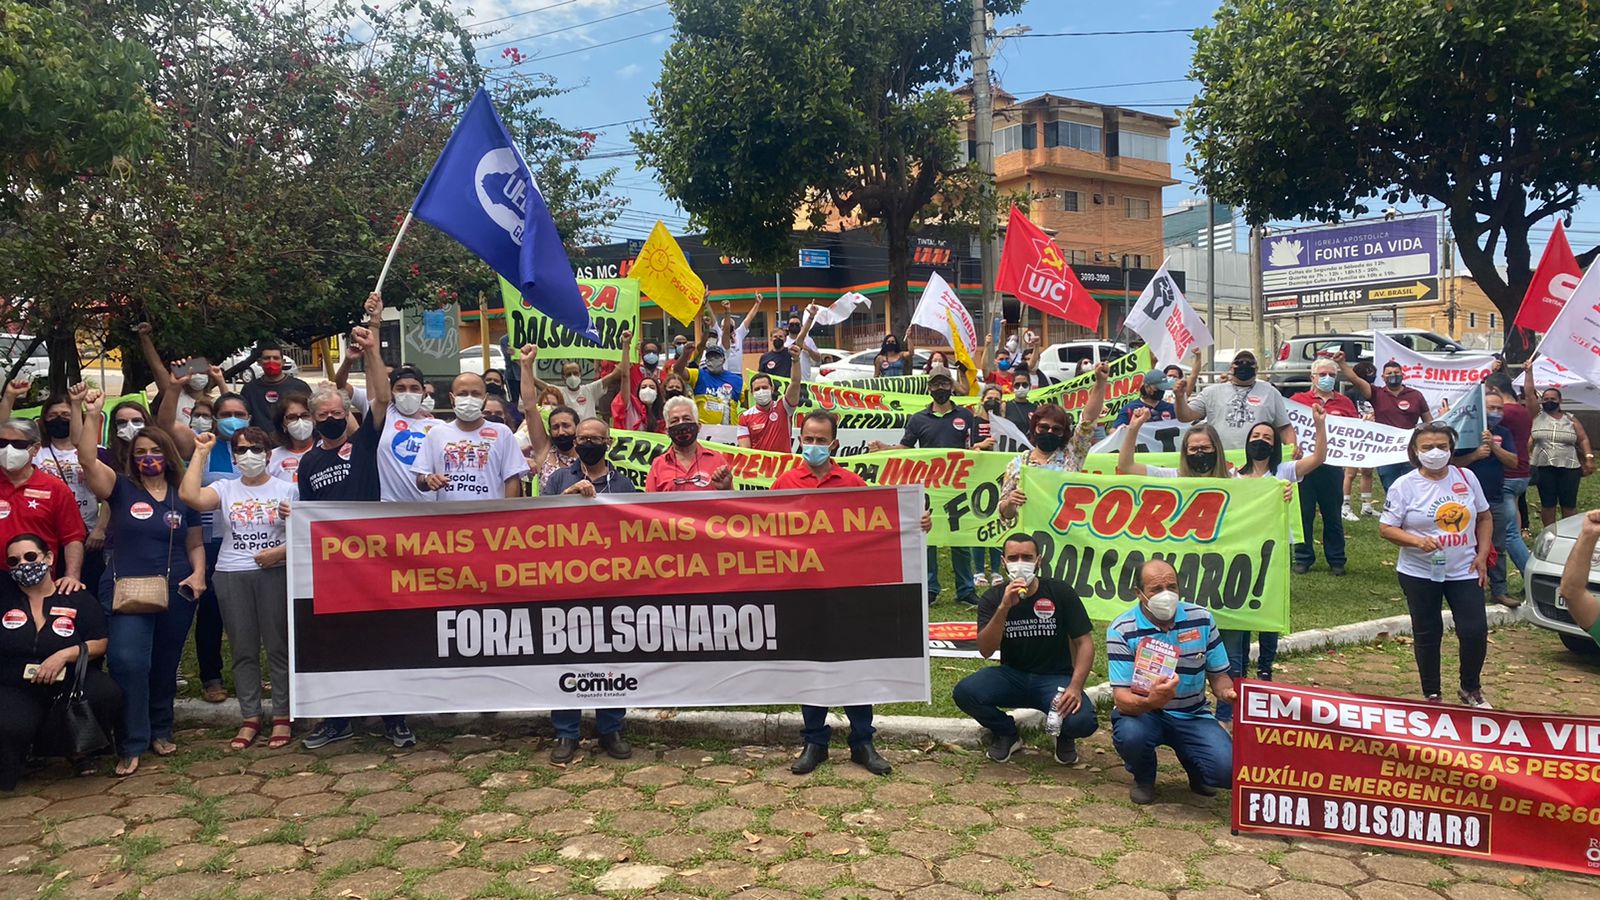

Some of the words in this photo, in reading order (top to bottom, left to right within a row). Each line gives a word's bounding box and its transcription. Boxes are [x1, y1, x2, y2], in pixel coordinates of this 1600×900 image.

[1314, 239, 1340, 247] IGREJA
[1314, 244, 1359, 261] FONTE
[1364, 242, 1384, 255] DA
[1387, 237, 1423, 253] VIDA
[596, 264, 618, 278] MC
[671, 276, 689, 296] PSOL
[688, 293, 700, 305] 50
[1028, 271, 1066, 302] UJC
[1302, 289, 1363, 304] unitintas
[1373, 290, 1385, 298] AV.
[1387, 288, 1413, 296] BRASIL
[1108, 352, 1138, 378] AIS
[1424, 367, 1491, 382] SINTEGO
[811, 383, 890, 411] VIDA
[1061, 373, 1145, 410] VAINA
[838, 412, 913, 430] RETORN
[1302, 429, 1347, 449] PEAS
[1349, 437, 1409, 454] VÍTIMAS
[1327, 423, 1394, 445] VERDADE
[1396, 436, 1407, 444] E
[1299, 440, 1366, 462] COID-19
[878, 451, 974, 490] MORTE
[457, 482, 489, 494] Praça
[1050, 482, 1230, 543] FORA
[232, 532, 268, 541] Escola
[233, 541, 246, 550] da
[321, 534, 388, 560] POR
[395, 529, 475, 557] MAIS
[482, 521, 611, 551] VACINA,
[619, 516, 697, 543] MAIS
[704, 509, 835, 539] COMIDA
[843, 506, 893, 532] NA
[1438, 533, 1468, 549] VIDA
[391, 566, 488, 593] MESA,
[496, 553, 710, 589] DEMOCRACIA
[717, 548, 825, 576] PLENA
[1031, 530, 1276, 610] BOLSOARO!
[436, 608, 535, 658] FORA
[542, 604, 778, 656] BOLSONARO!
[559, 672, 638, 693] Comide
[577, 671, 606, 679] ANTÔNIO
[1247, 691, 1302, 721] EM
[1311, 698, 1461, 743] DEFESA
[1471, 716, 1532, 748] DA
[1254, 726, 1335, 752] VACINA
[1338, 735, 1400, 760] PARA
[1406, 744, 1484, 771] TODAS
[1488, 755, 1520, 775] AS
[1526, 758, 1600, 784] PESSO
[1379, 760, 1498, 792] EMPREGO
[1236, 764, 1325, 790] AUXÍLIO
[1328, 774, 1494, 810] EMERGENCIAL
[1498, 796, 1534, 815] DE
[1249, 792, 1312, 827] FORA
[1323, 799, 1482, 848] BOLSONARO
